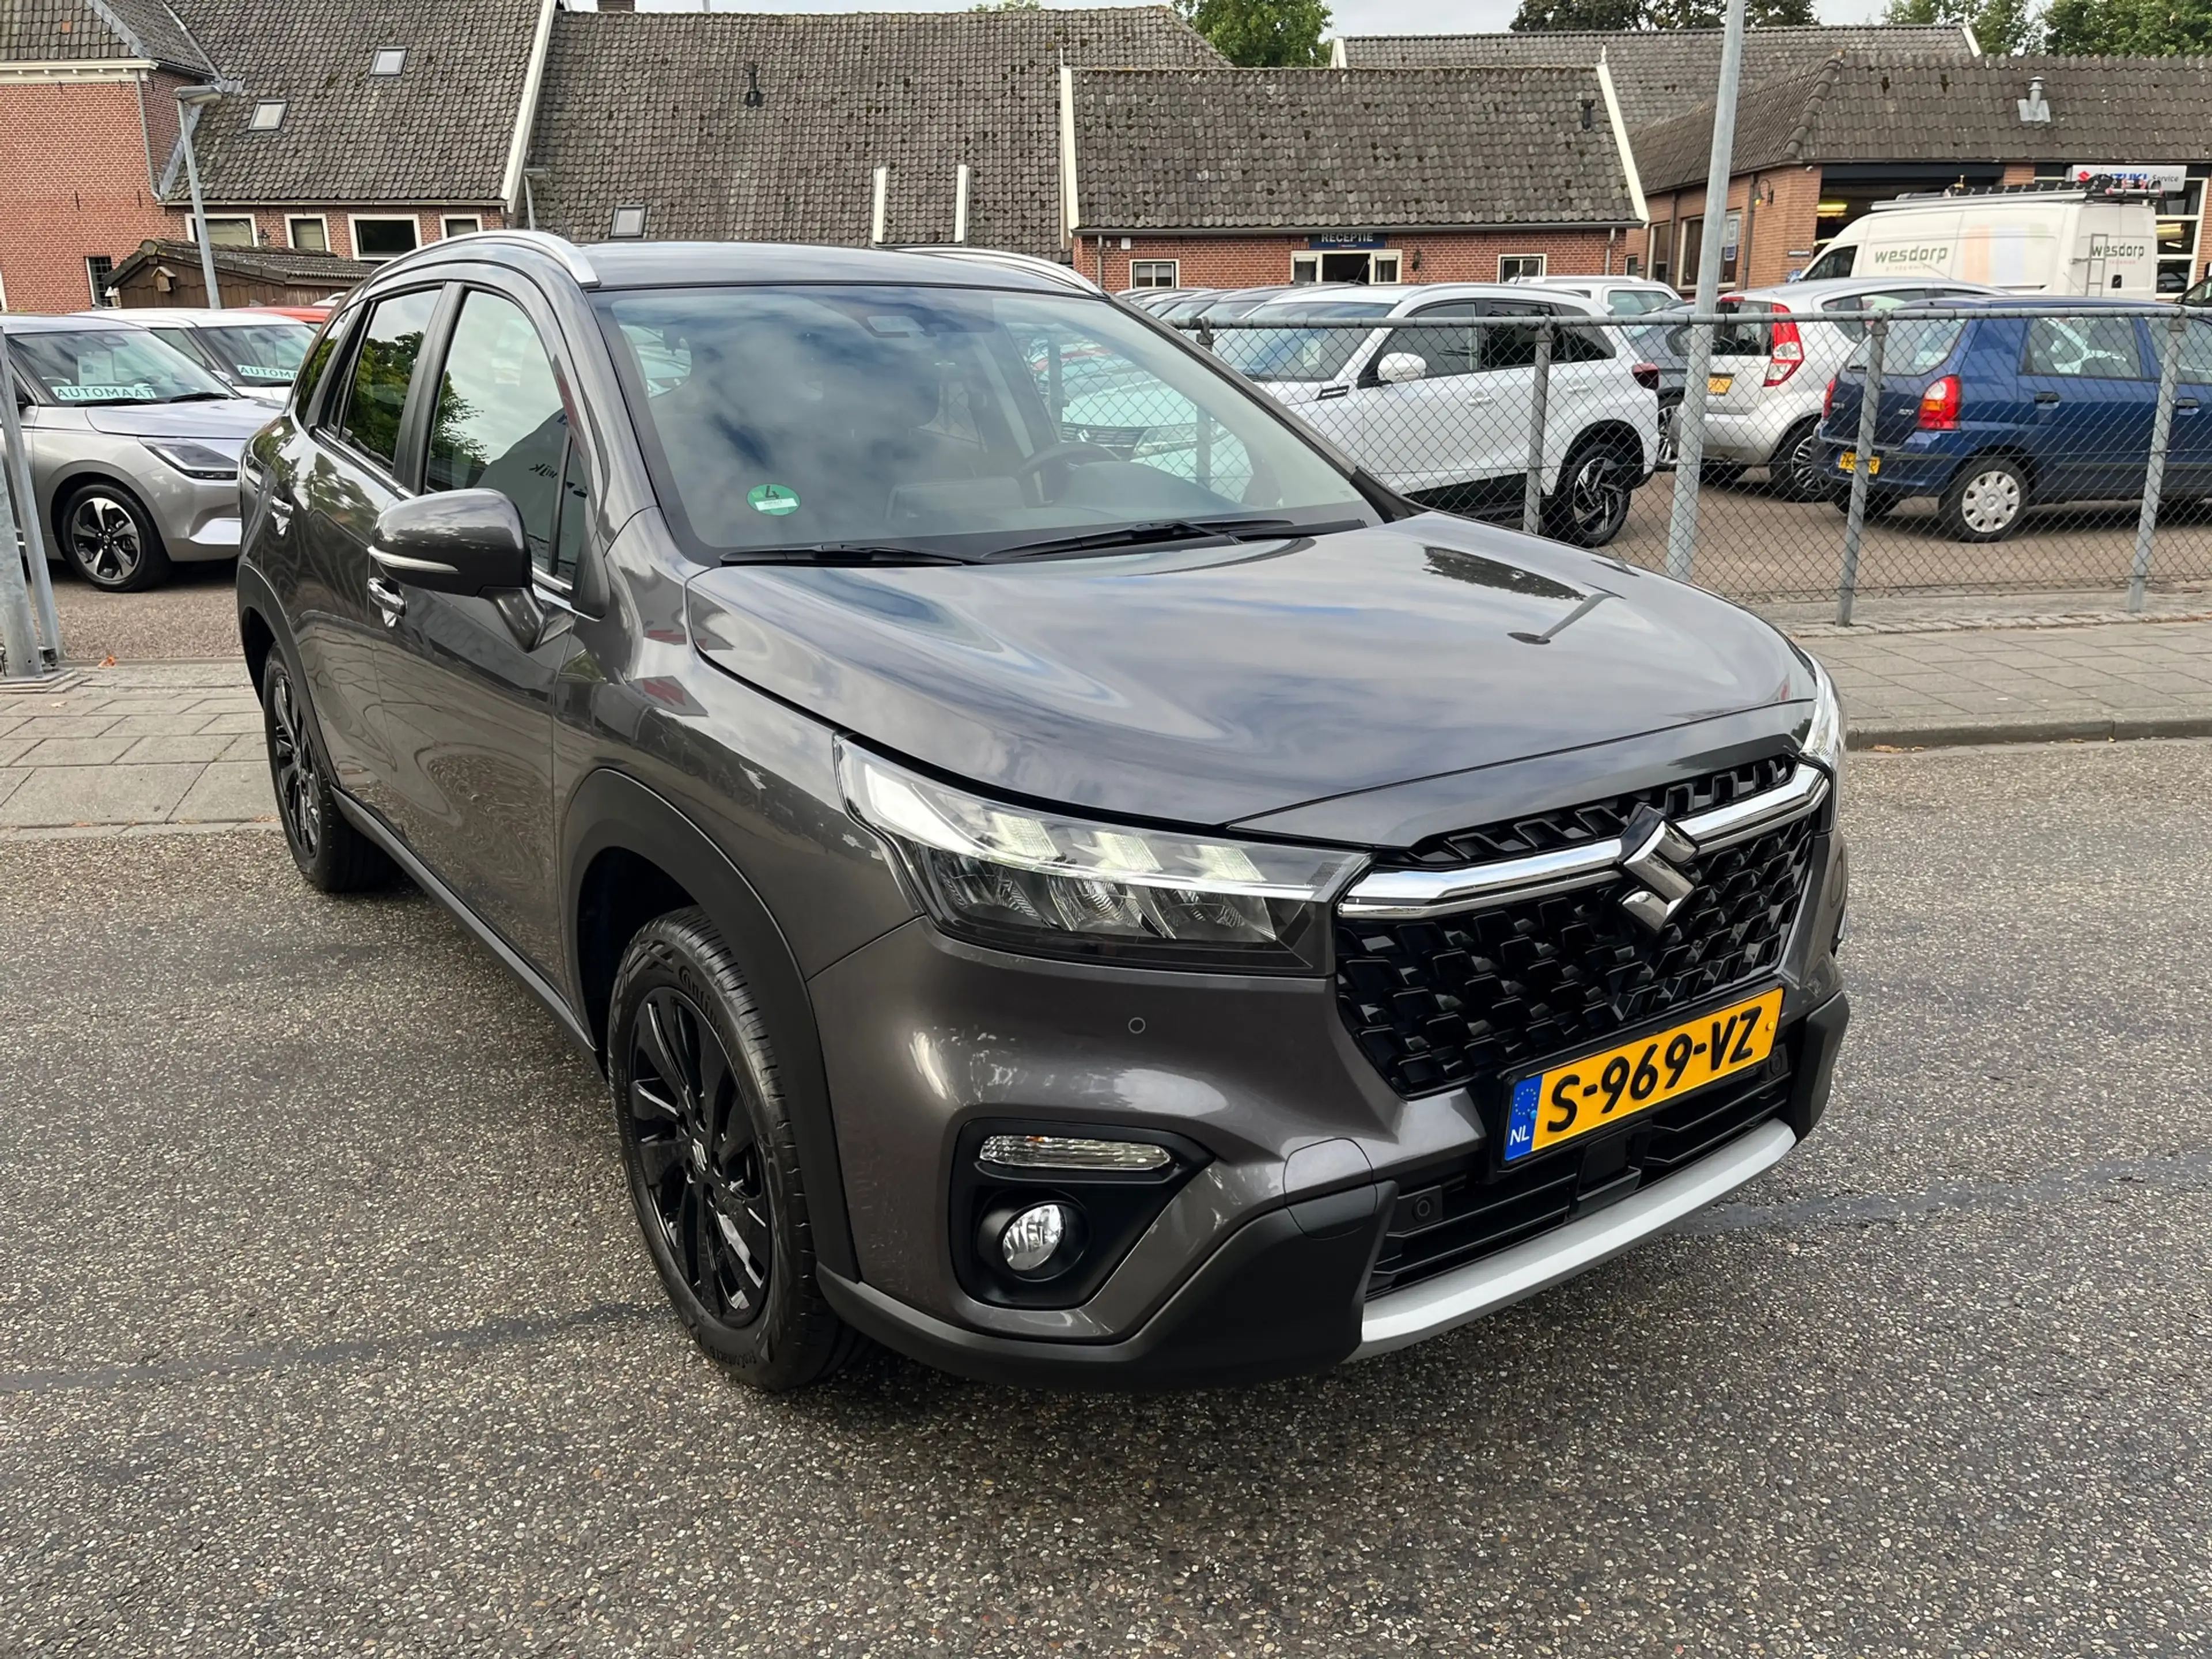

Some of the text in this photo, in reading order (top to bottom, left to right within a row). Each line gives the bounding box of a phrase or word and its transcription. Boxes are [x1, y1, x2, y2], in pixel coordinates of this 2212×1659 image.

[1321, 232, 1373, 243] RECEPTIE
[1874, 245, 1948, 264] wesdorp
[2091, 242, 2145, 260] wesdorp
[57, 388, 154, 398] AUTOMAAT
[765, 485, 779, 499] 4
[1547, 1005, 1763, 1132] S-969-VZ
[1509, 1124, 1530, 1146] NL
